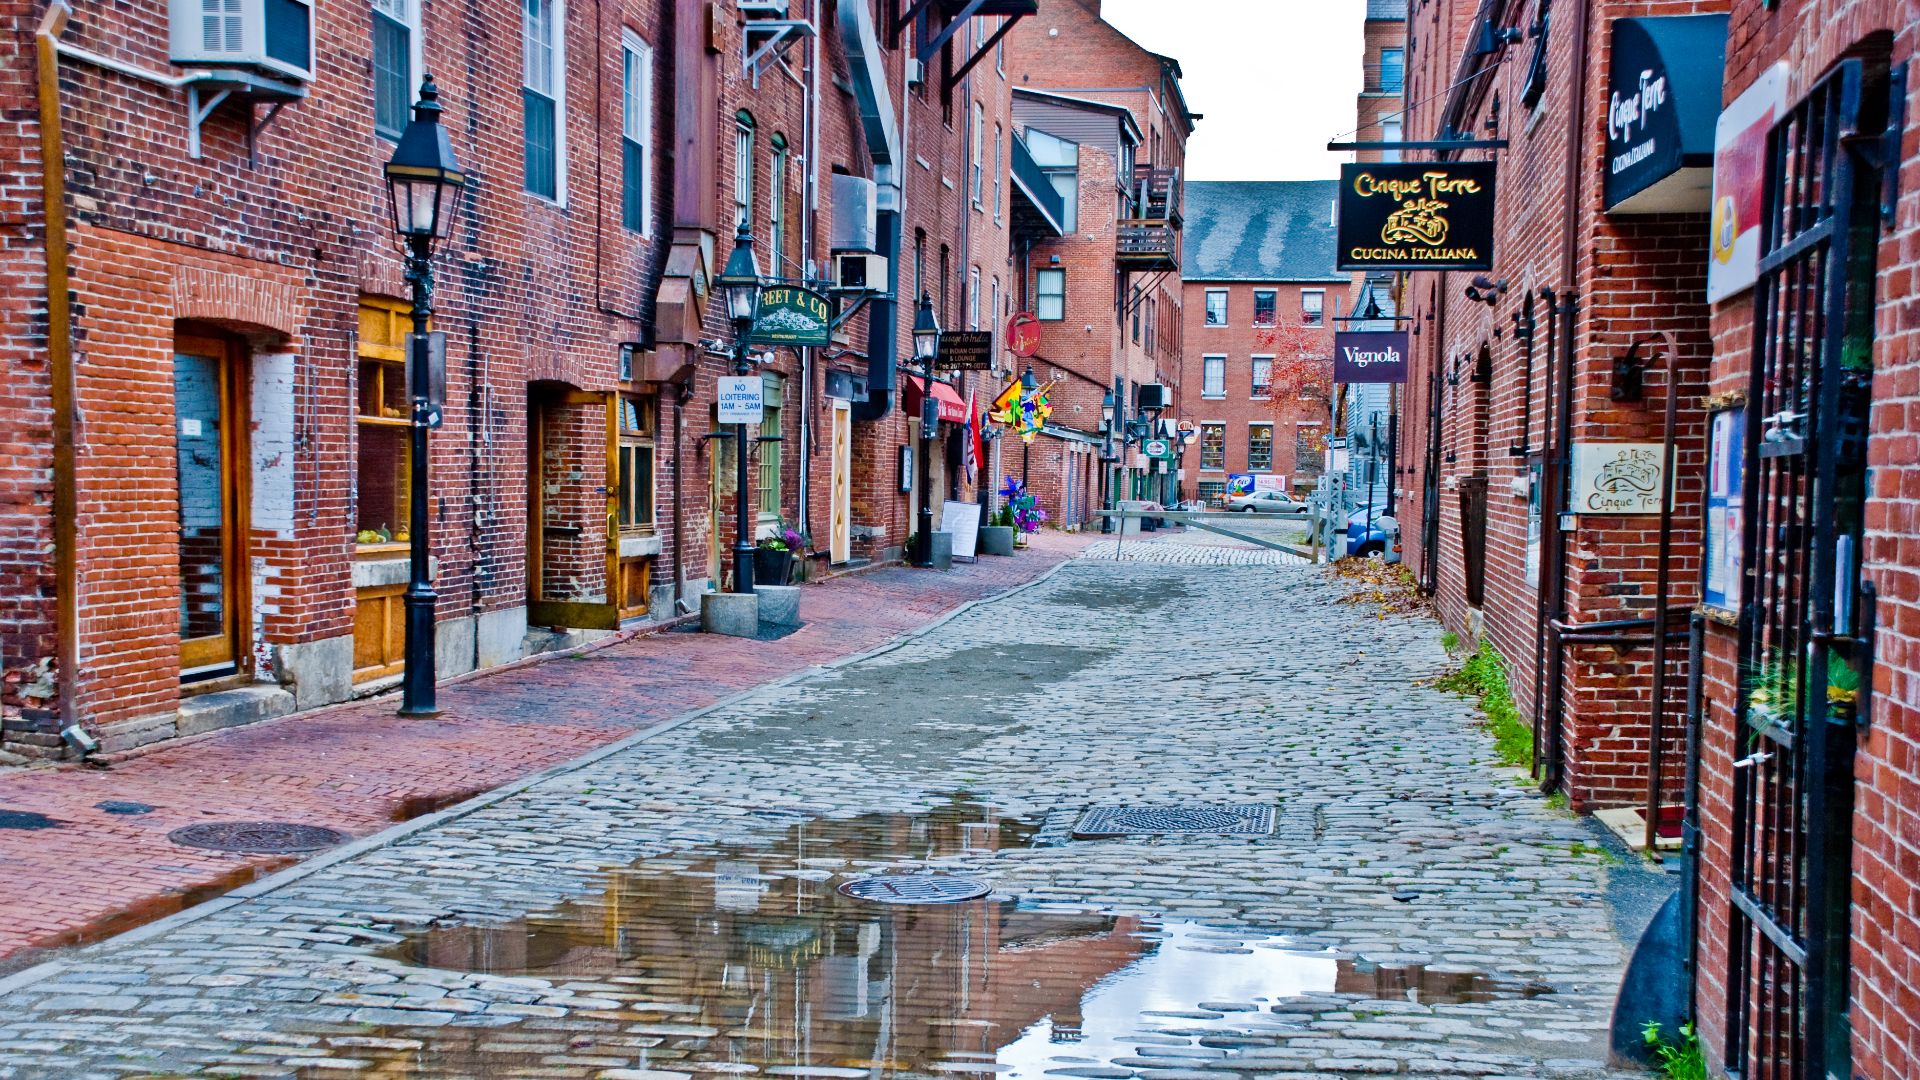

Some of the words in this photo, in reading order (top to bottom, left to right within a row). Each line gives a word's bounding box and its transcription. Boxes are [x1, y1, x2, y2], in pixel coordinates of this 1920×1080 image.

[1609, 90, 1640, 143] Cinque
[1639, 69, 1665, 131] Terre
[1354, 172, 1422, 201] Cinque
[1423, 171, 1481, 200] Terre
[1351, 248, 1408, 260] CUCINA
[1411, 248, 1477, 260] ITALIANA
[796, 291, 806, 308] &
[1343, 346, 1400, 368] Vignola
[734, 383, 746, 391] NO
[720, 393, 760, 401] LOITERING
[721, 402, 735, 410] 1AM
[744, 402, 761, 410] 5AM
[1588, 492, 1633, 511] Cinque
